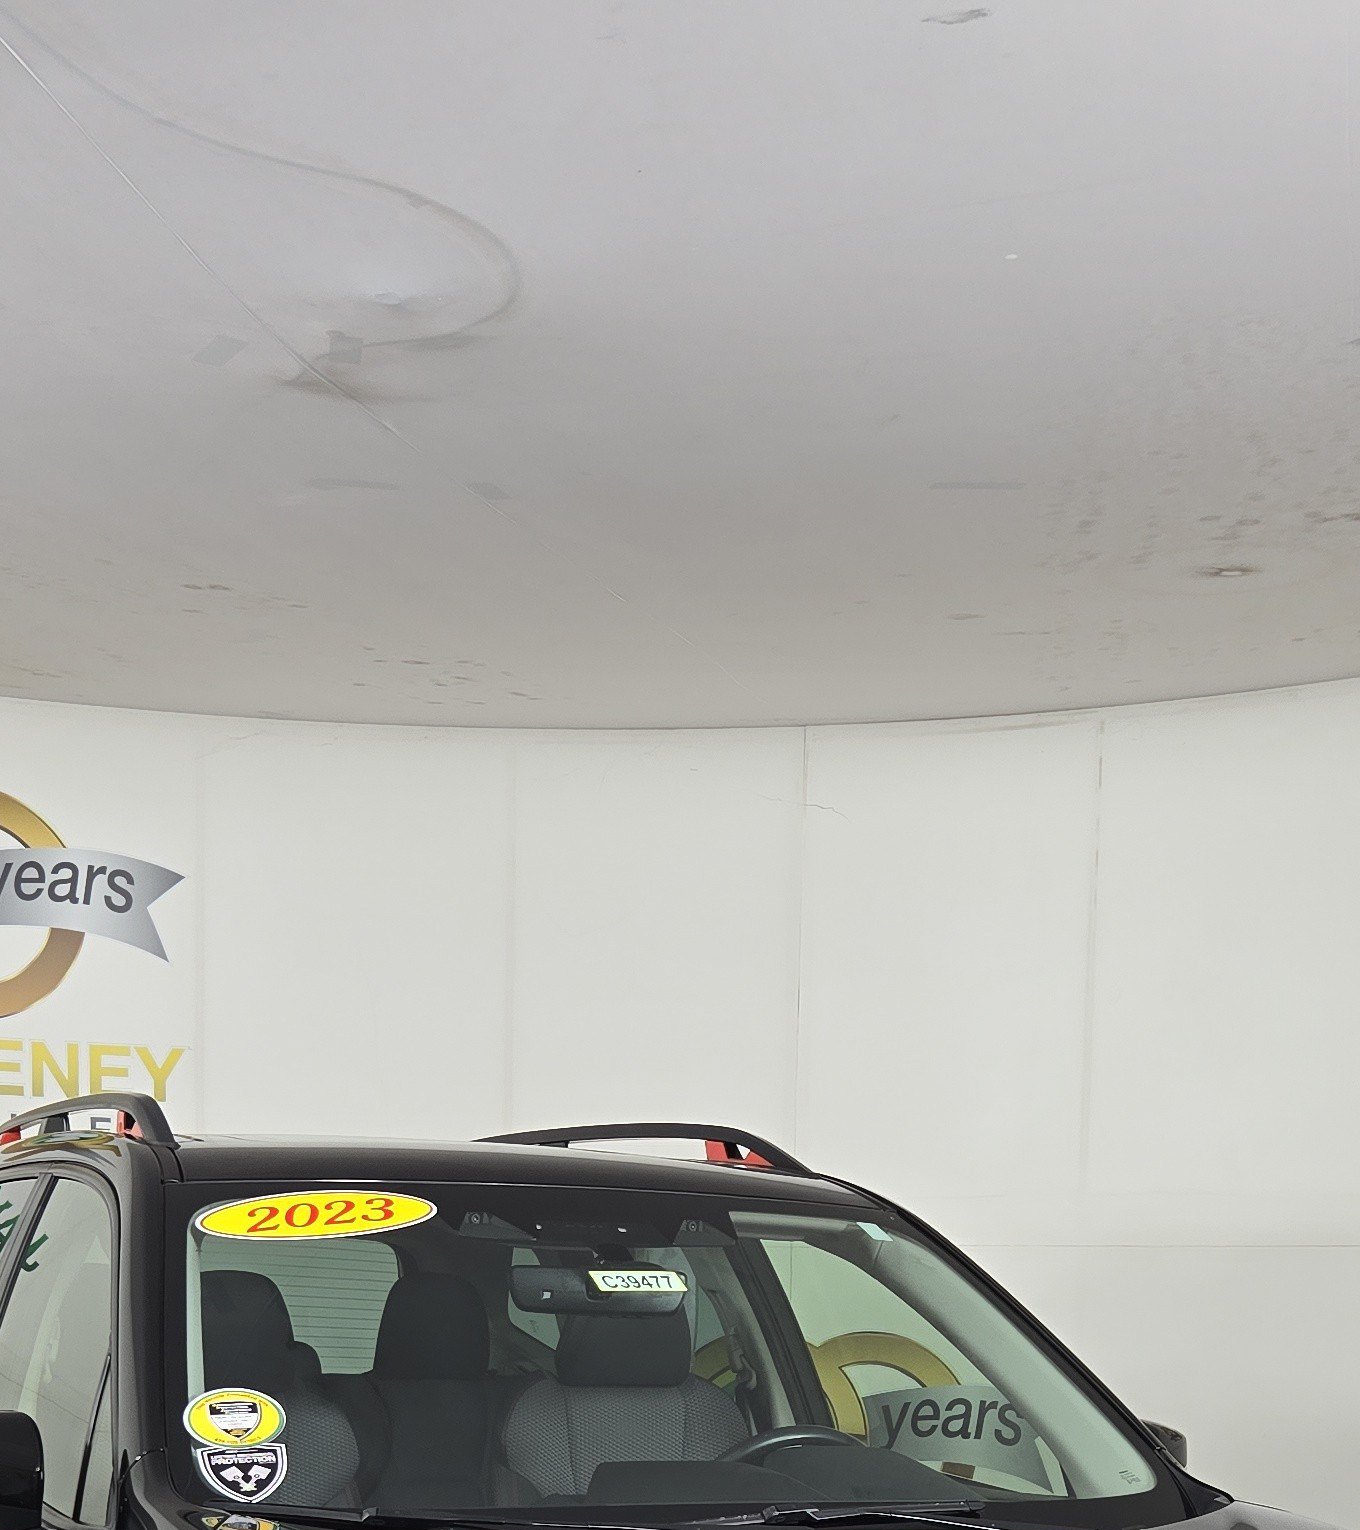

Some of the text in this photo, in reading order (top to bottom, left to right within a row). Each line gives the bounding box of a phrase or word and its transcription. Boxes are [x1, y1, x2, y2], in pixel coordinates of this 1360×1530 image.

[246, 1197, 395, 1233] 2023
[601, 1275, 673, 1289] C39477
[881, 1397, 1024, 1450] years
